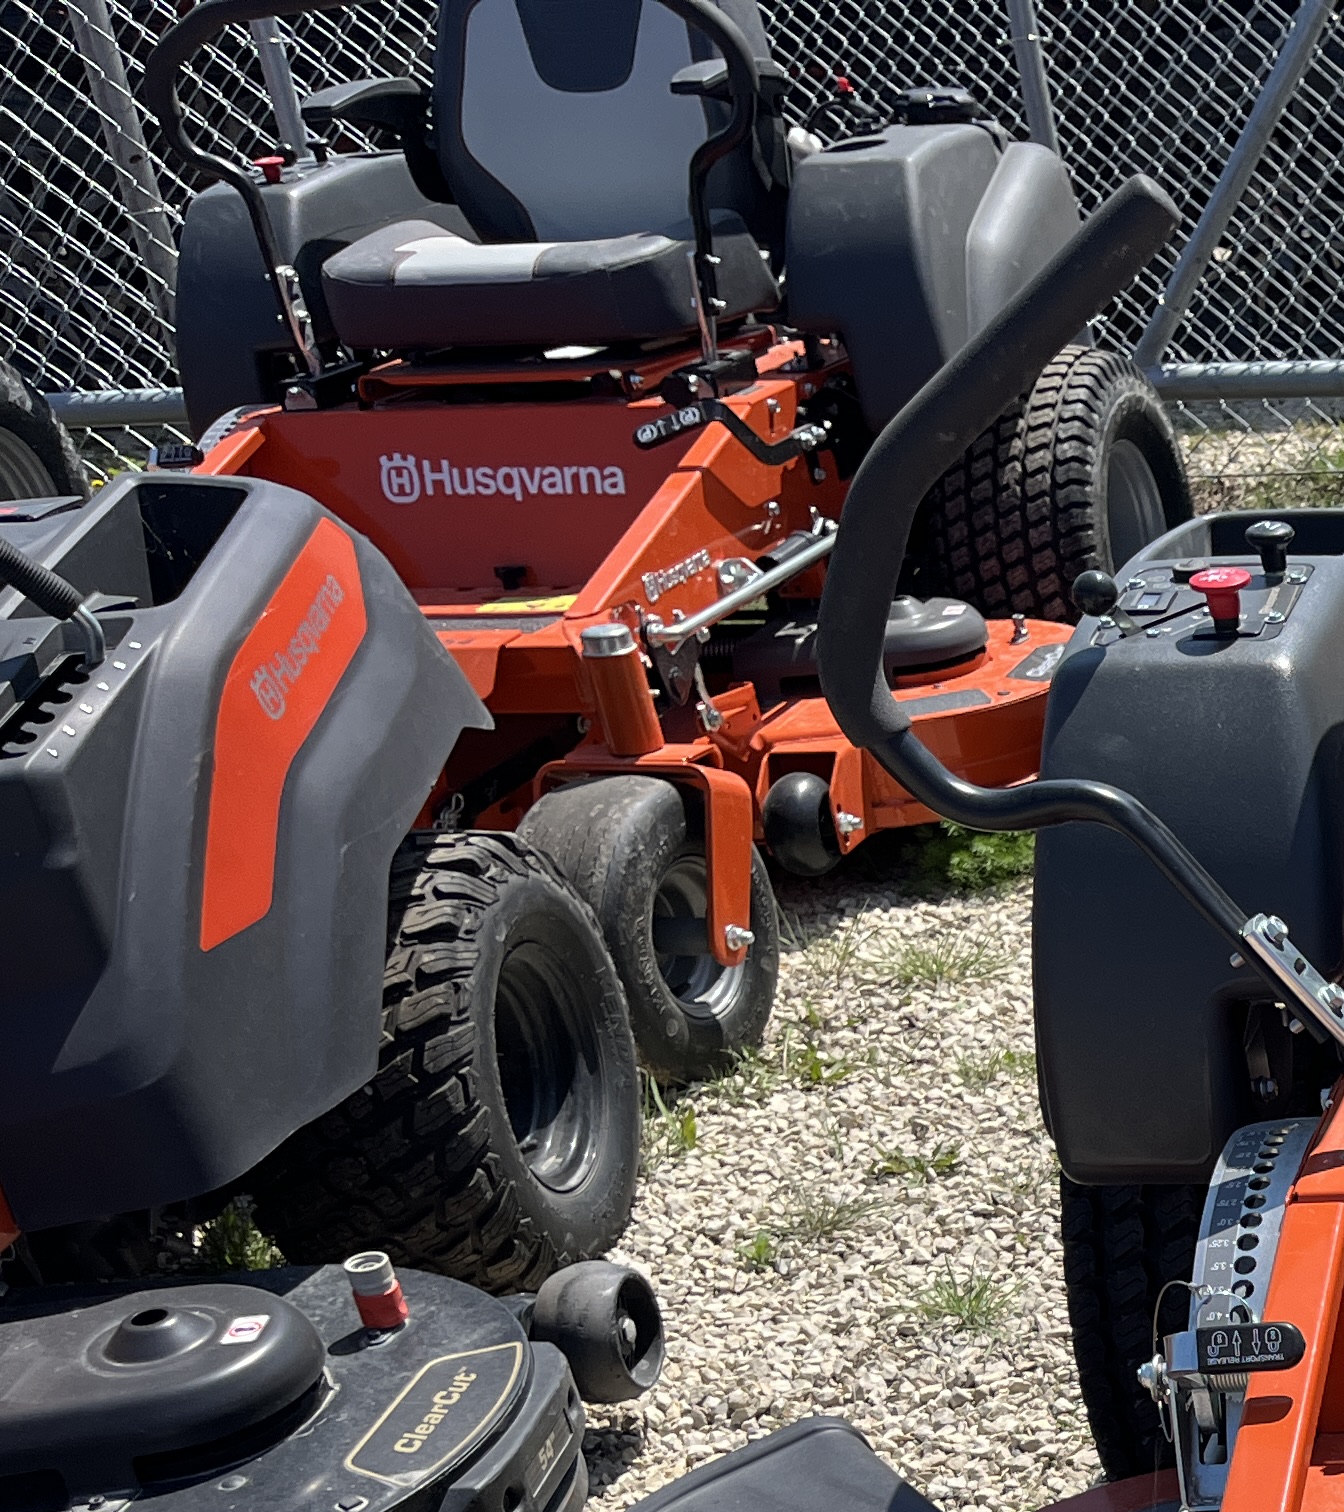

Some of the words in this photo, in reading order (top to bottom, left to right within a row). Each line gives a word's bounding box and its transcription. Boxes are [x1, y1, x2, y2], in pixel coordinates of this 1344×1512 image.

[422, 459, 627, 502] Husqvarna
[268, 574, 345, 694] Husqvarna
[1206, 1356, 1241, 1366] RELEASE
[1241, 1353, 1285, 1364] TRANSPORT
